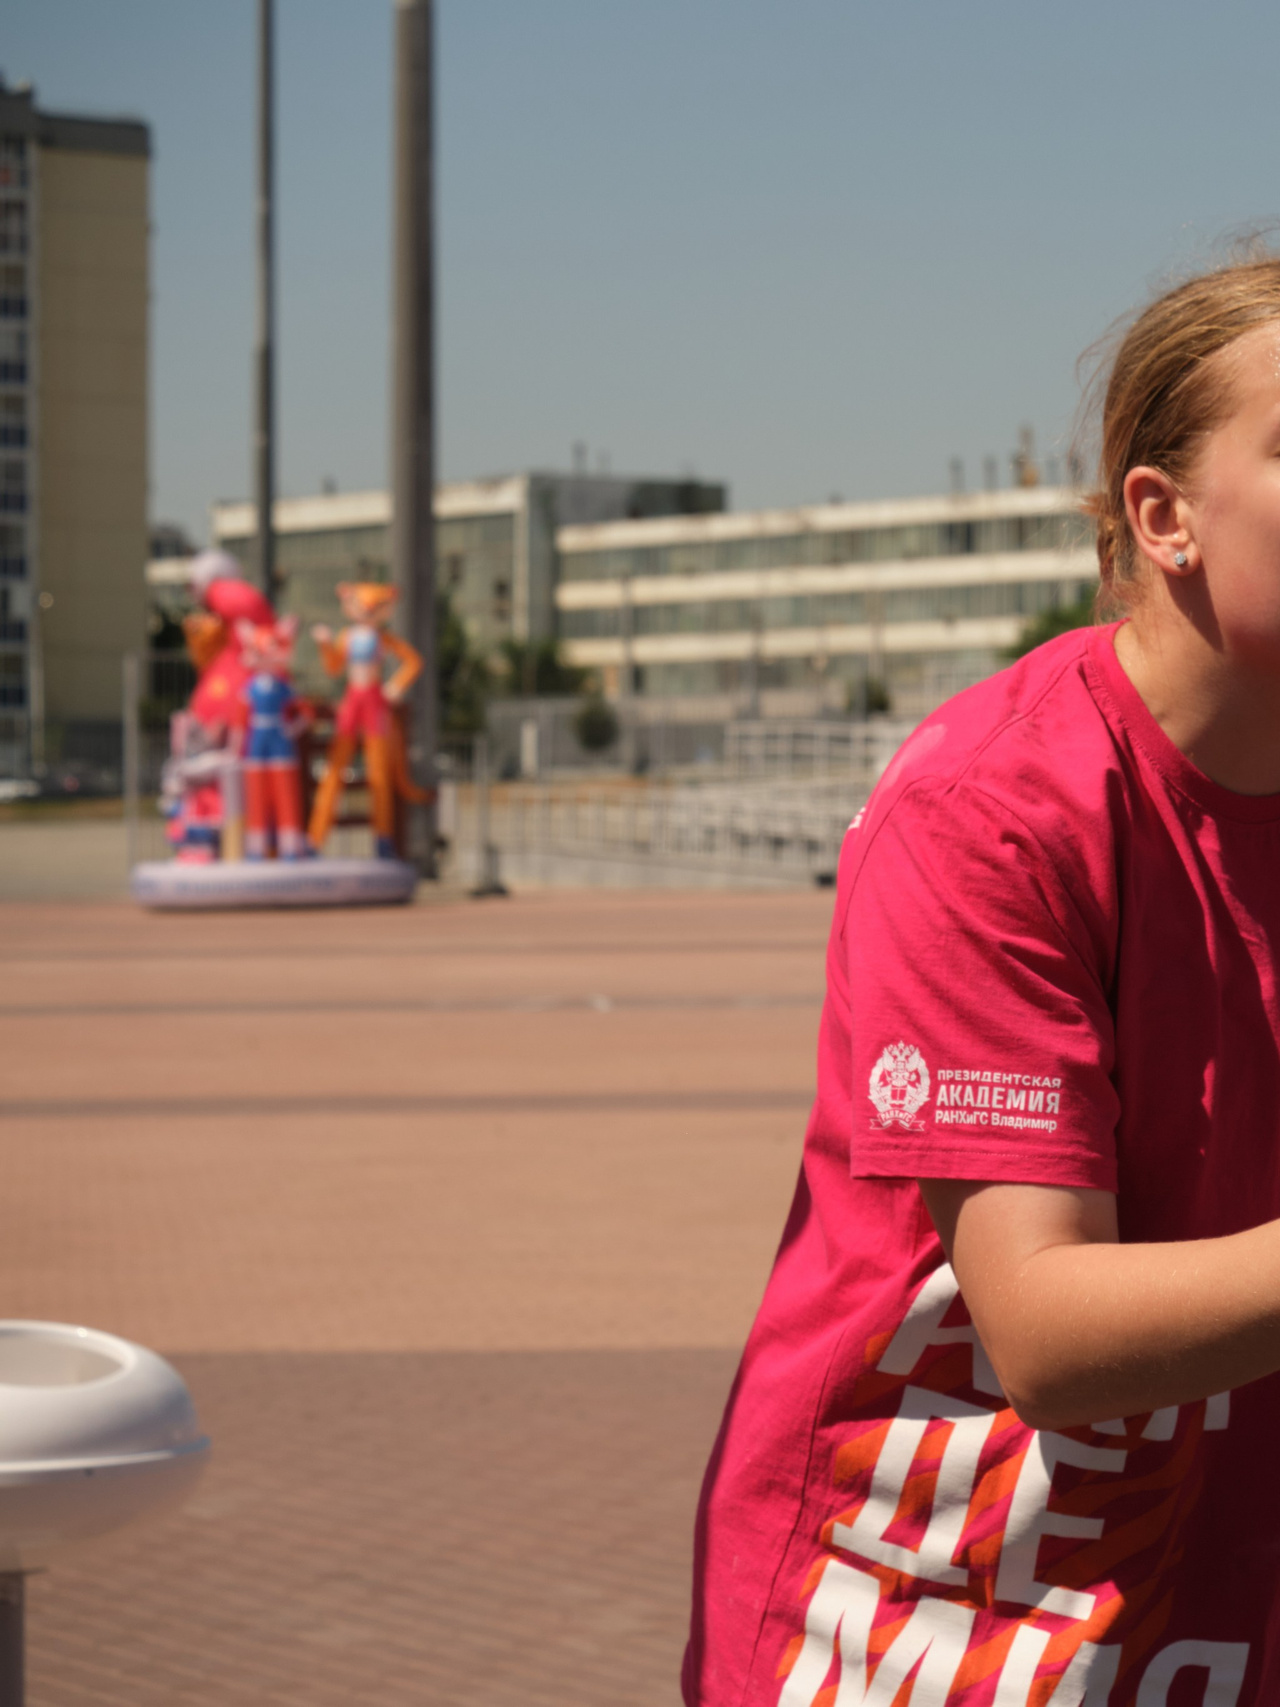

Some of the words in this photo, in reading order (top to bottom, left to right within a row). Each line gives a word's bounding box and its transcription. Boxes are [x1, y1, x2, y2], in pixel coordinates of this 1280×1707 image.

[937, 1069, 1062, 1089] ПРЕЗИДЕНТСКАЯ
[936, 1084, 1060, 1115] АКАДЕМИЯ
[935, 1110, 989, 1125] РАНХиГС
[991, 1112, 1057, 1133] Владимир
